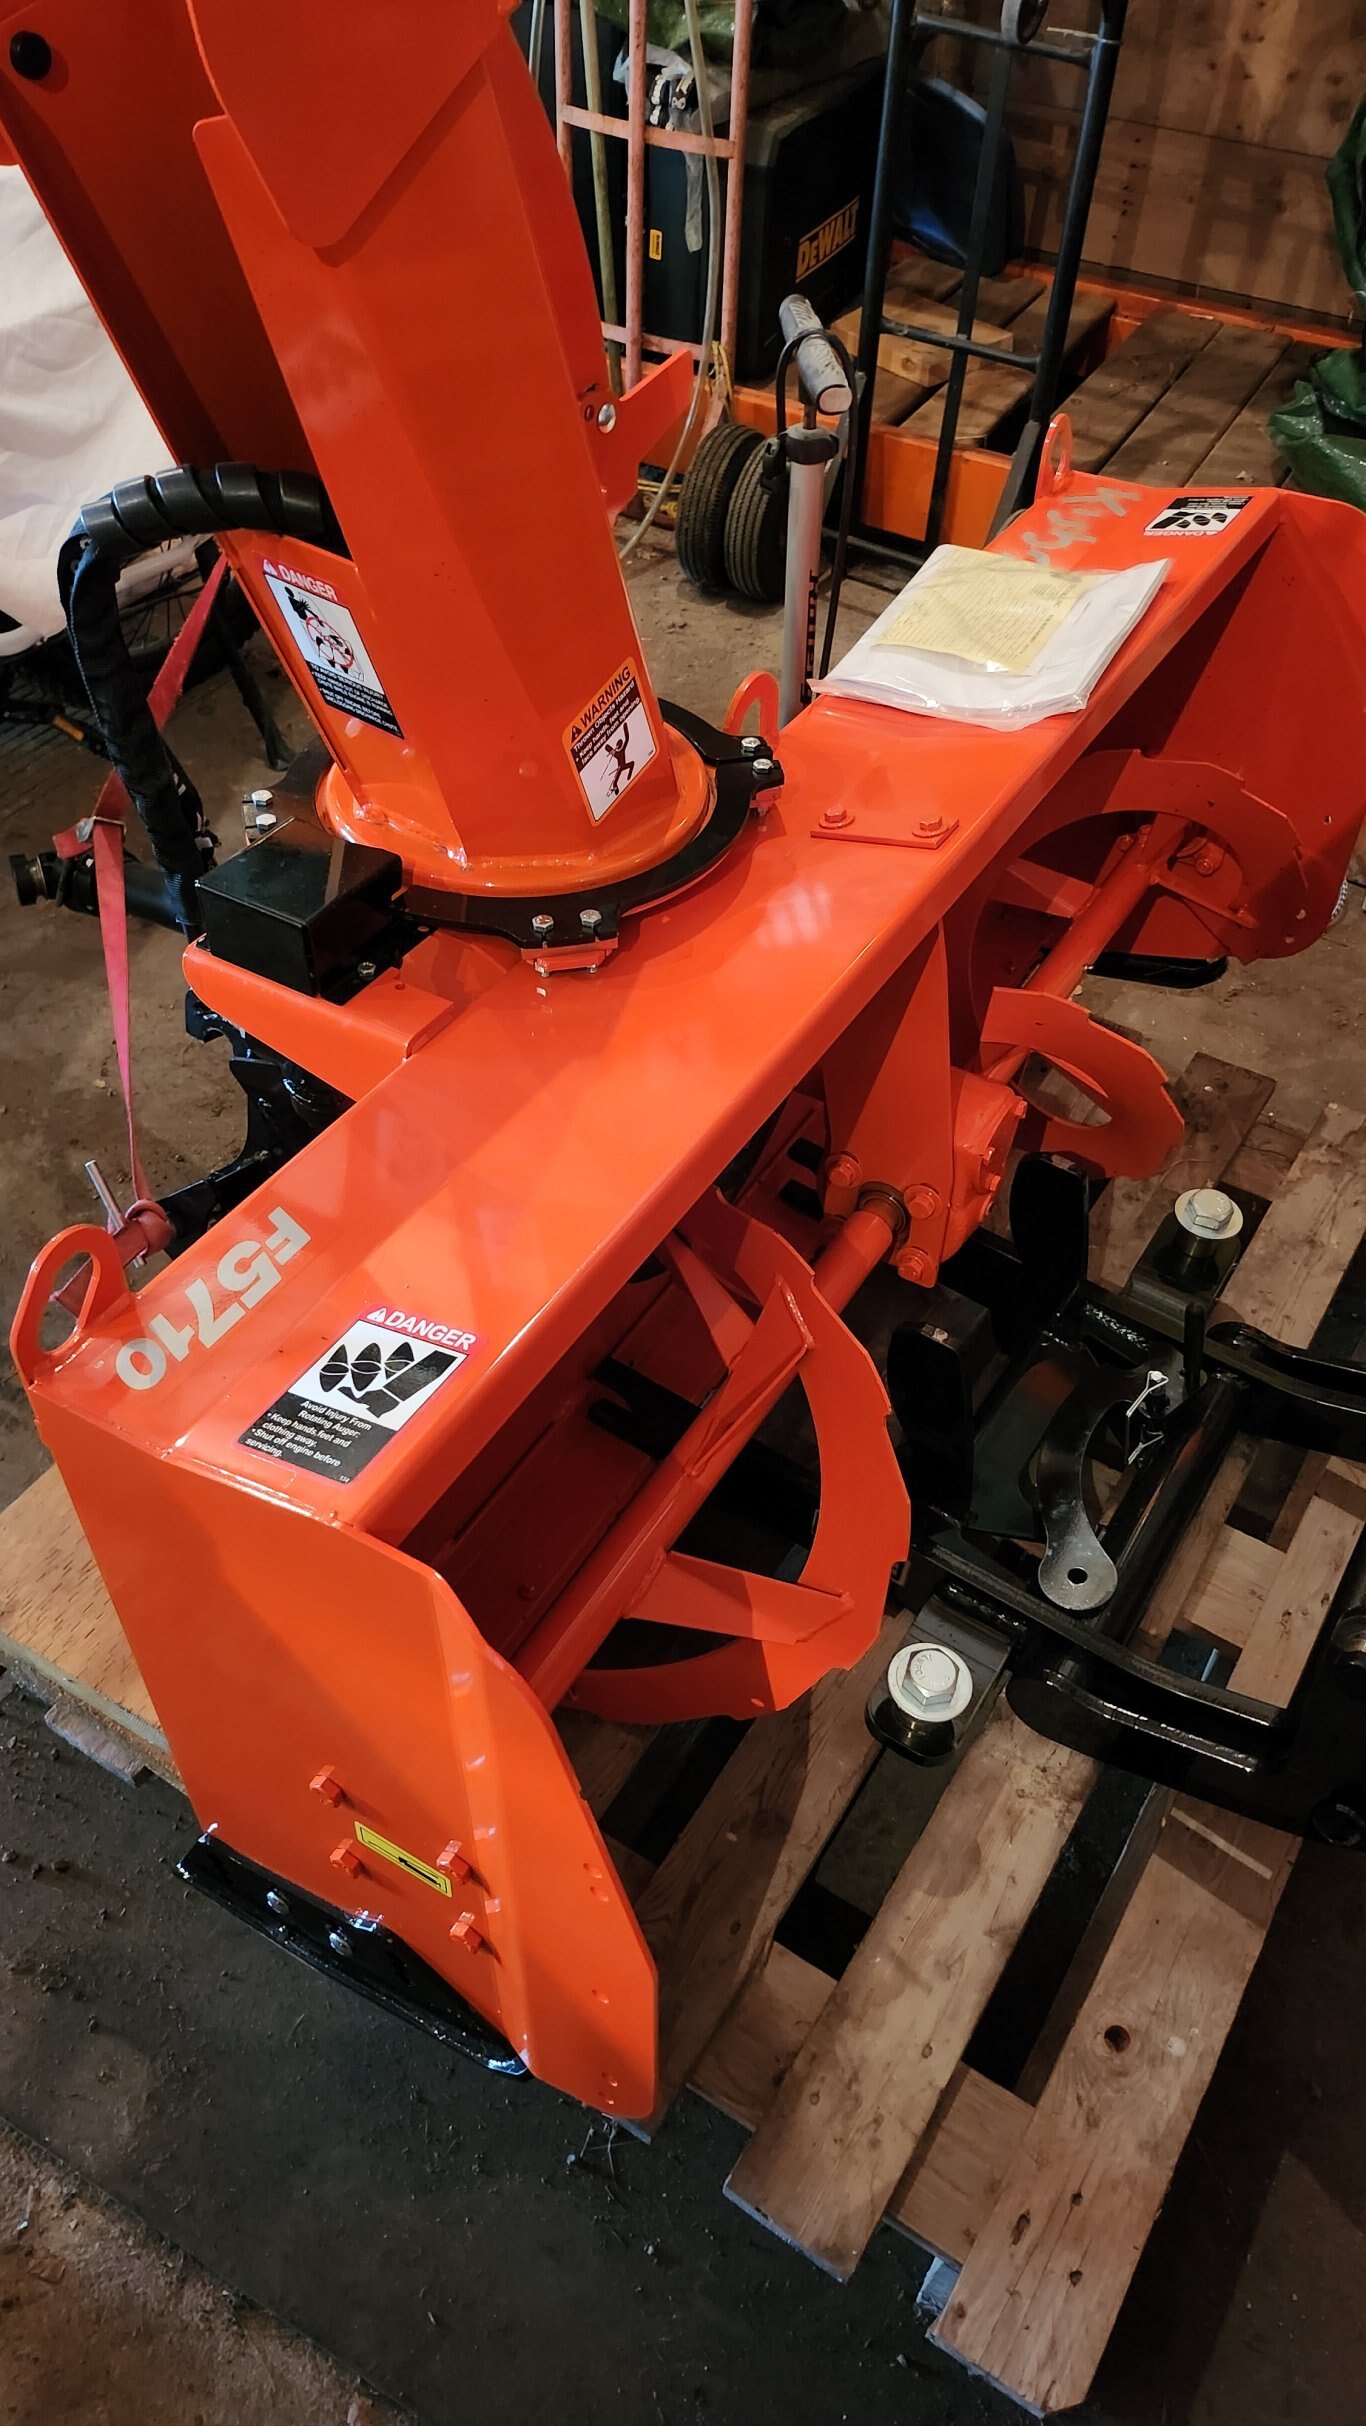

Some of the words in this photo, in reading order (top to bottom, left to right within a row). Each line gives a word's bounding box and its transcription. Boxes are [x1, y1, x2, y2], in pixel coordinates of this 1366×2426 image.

[796, 199, 859, 278] DeWALT
[278, 564, 338, 602] DANGER
[580, 666, 631, 728] WARNING
[619, 698, 630, 711] and
[573, 727, 595, 752] Thrown
[594, 703, 616, 730] Objects
[615, 679, 635, 704] Hazard
[581, 751, 594, 766] face
[593, 736, 607, 754] away
[606, 720, 620, 737] from
[115, 1206, 312, 1390] F5710
[384, 1311, 477, 1351] DANGER
[298, 1409, 333, 1429] Rotating
[300, 1400, 327, 1414] Avoid
[325, 1409, 349, 1424] Injury
[348, 1417, 372, 1431] From
[244, 1437, 283, 1458] servicing.
[262, 1421, 296, 1441] clothing
[294, 1434, 318, 1448] away.
[275, 1435, 288, 1446] off
[286, 1440, 315, 1458] engine
[313, 1450, 342, 1468] before
[333, 1436, 353, 1448] and
